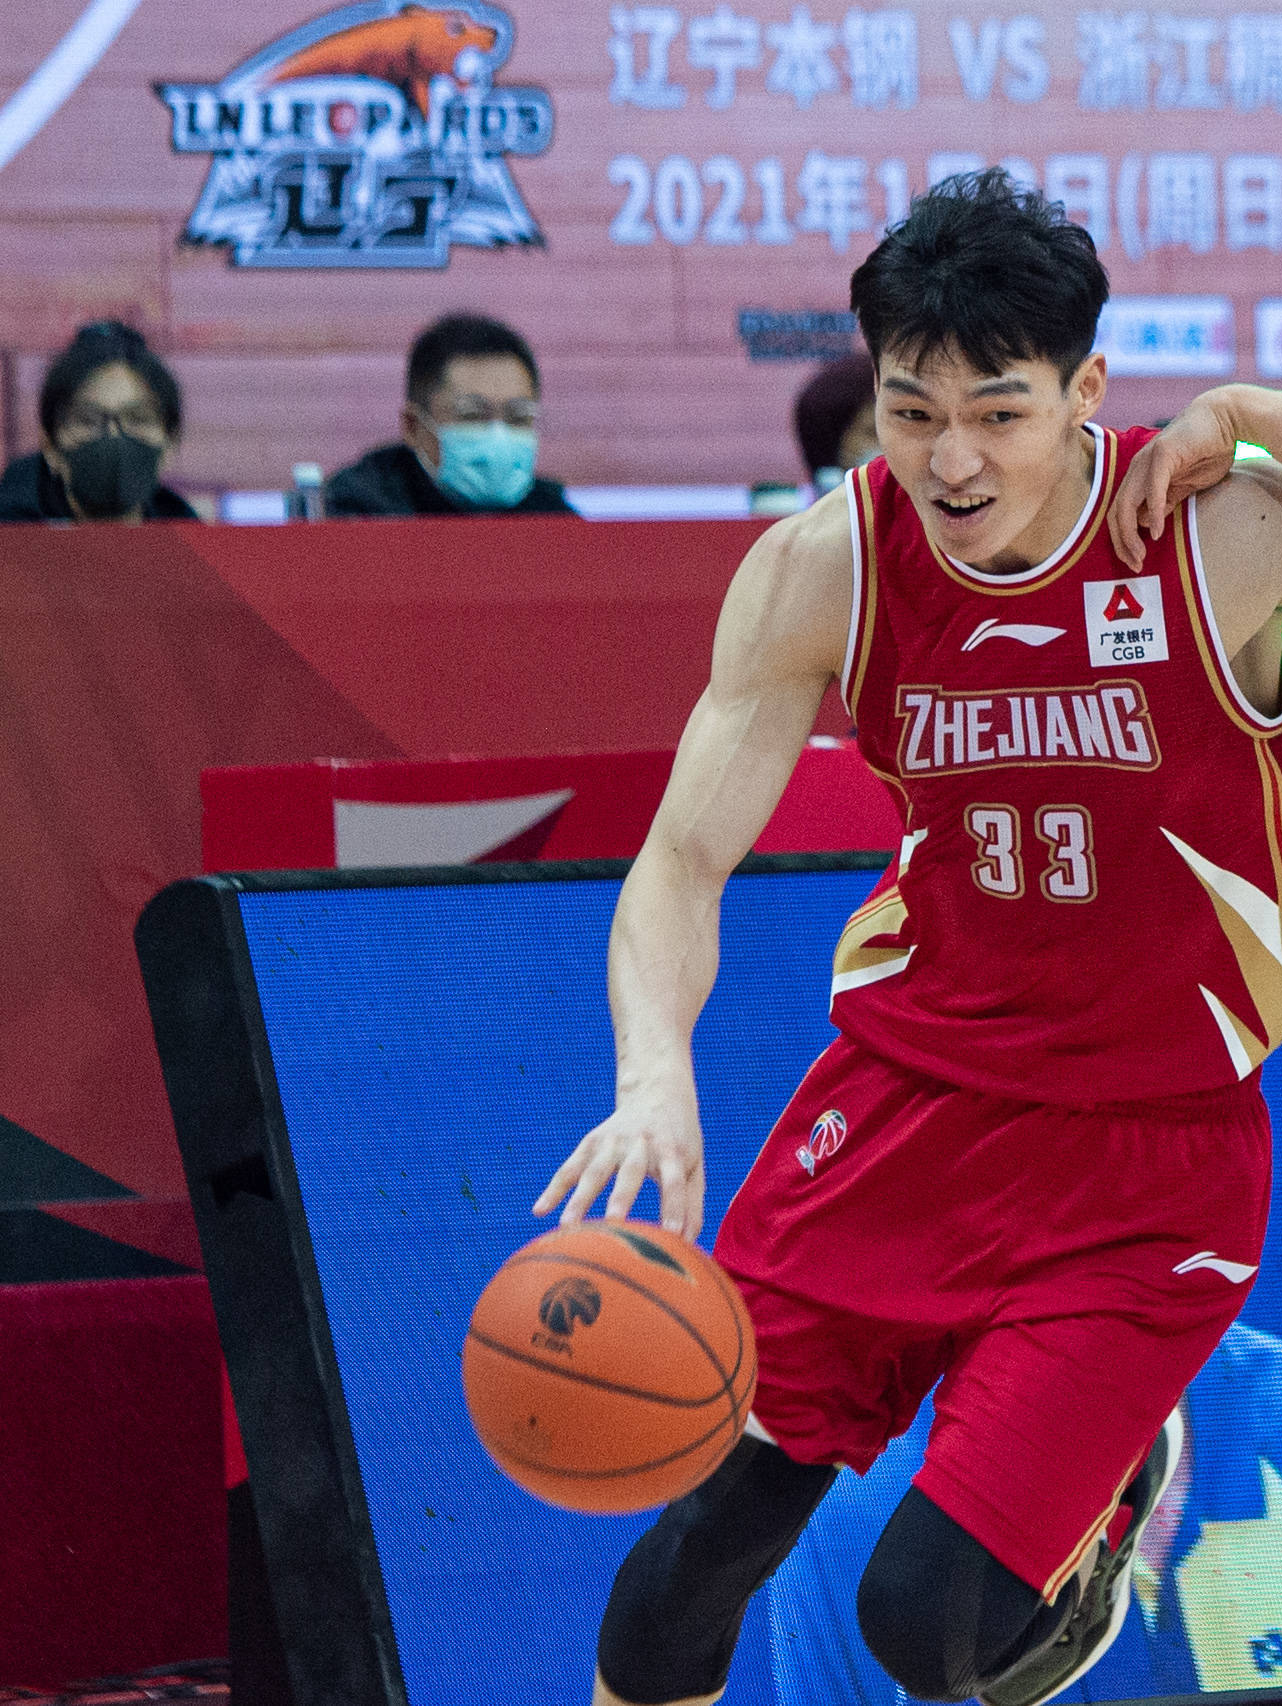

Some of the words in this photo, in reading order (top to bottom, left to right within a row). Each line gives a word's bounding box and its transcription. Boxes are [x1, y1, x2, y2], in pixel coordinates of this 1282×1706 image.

[948, 15, 1051, 103] VS
[1100, 628, 1153, 646] 广发银行
[1112, 645, 1145, 661] CGB
[904, 687, 1153, 770] ZHEJIANG
[968, 806, 1094, 901] 33
